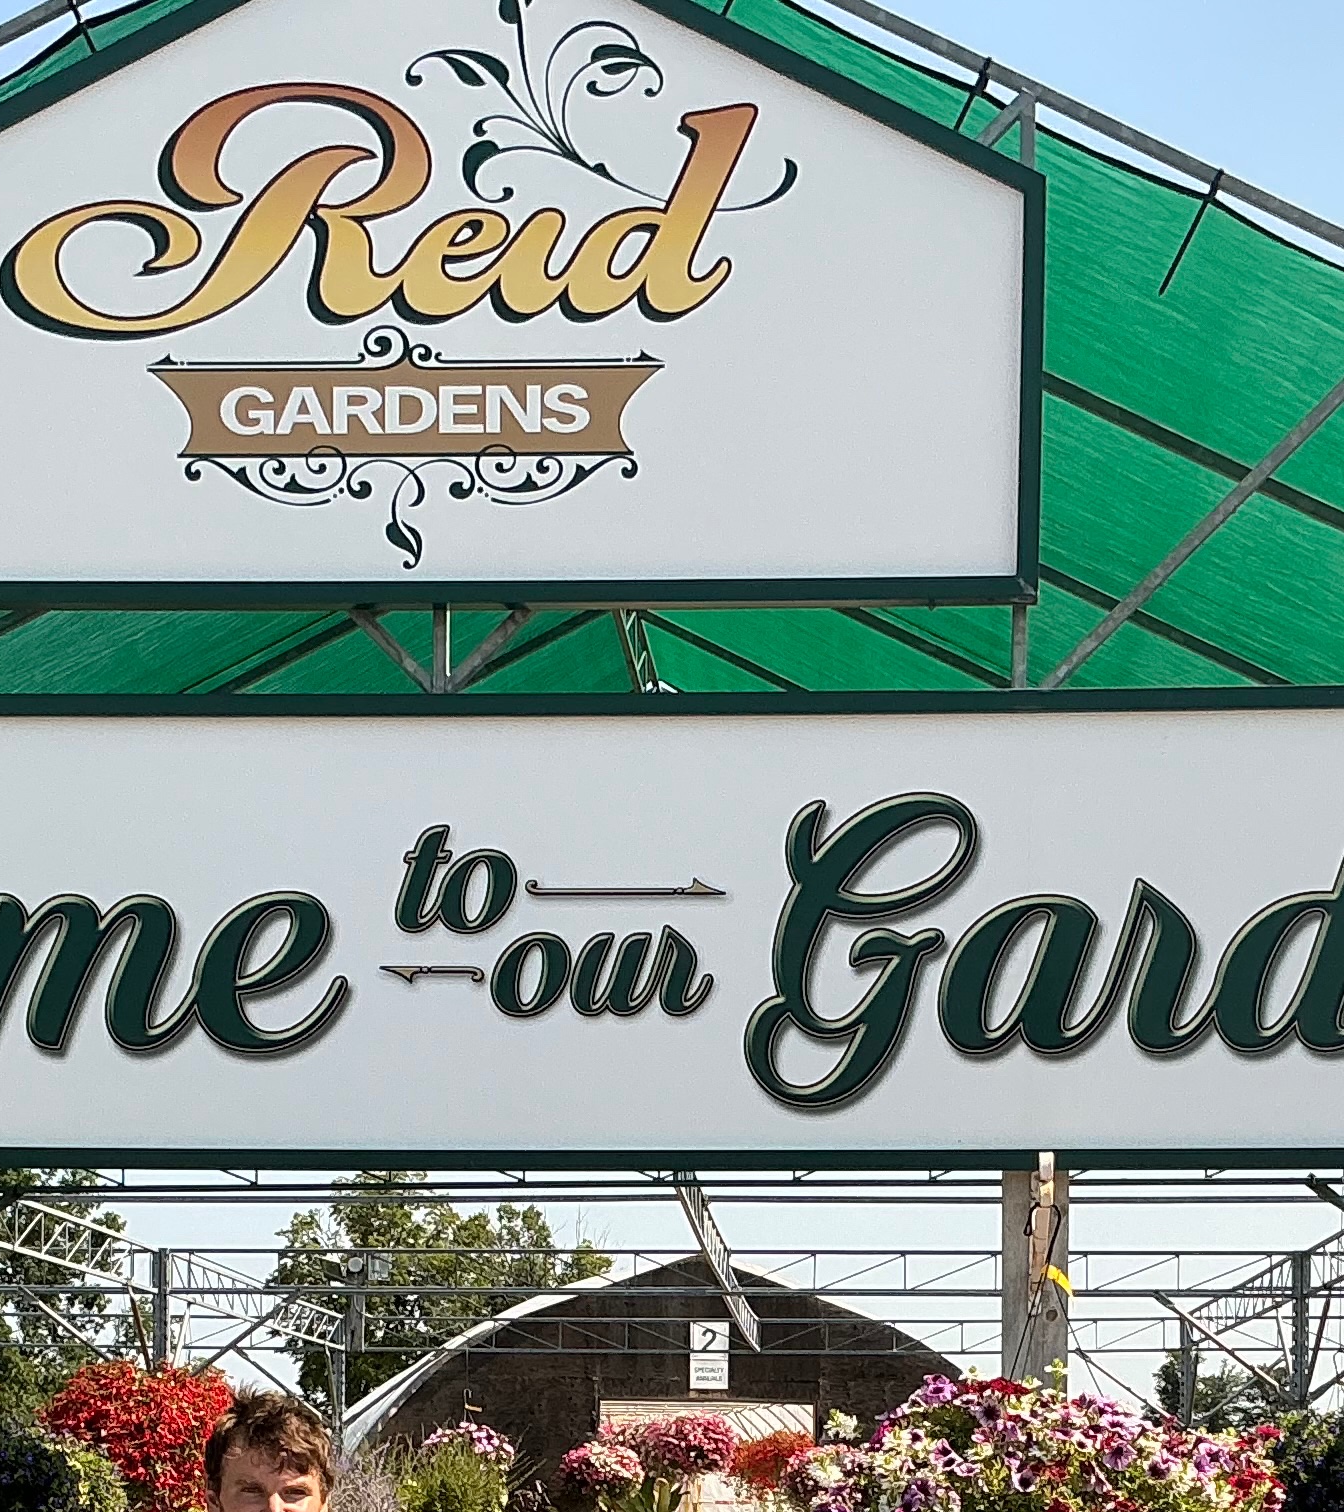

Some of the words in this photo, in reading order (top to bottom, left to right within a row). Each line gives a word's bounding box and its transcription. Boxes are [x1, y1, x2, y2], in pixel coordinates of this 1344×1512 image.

[219, 383, 592, 437] GARDENS
[394, 824, 518, 935] to
[490, 926, 712, 1018] our
[701, 1328, 717, 1351] 2
